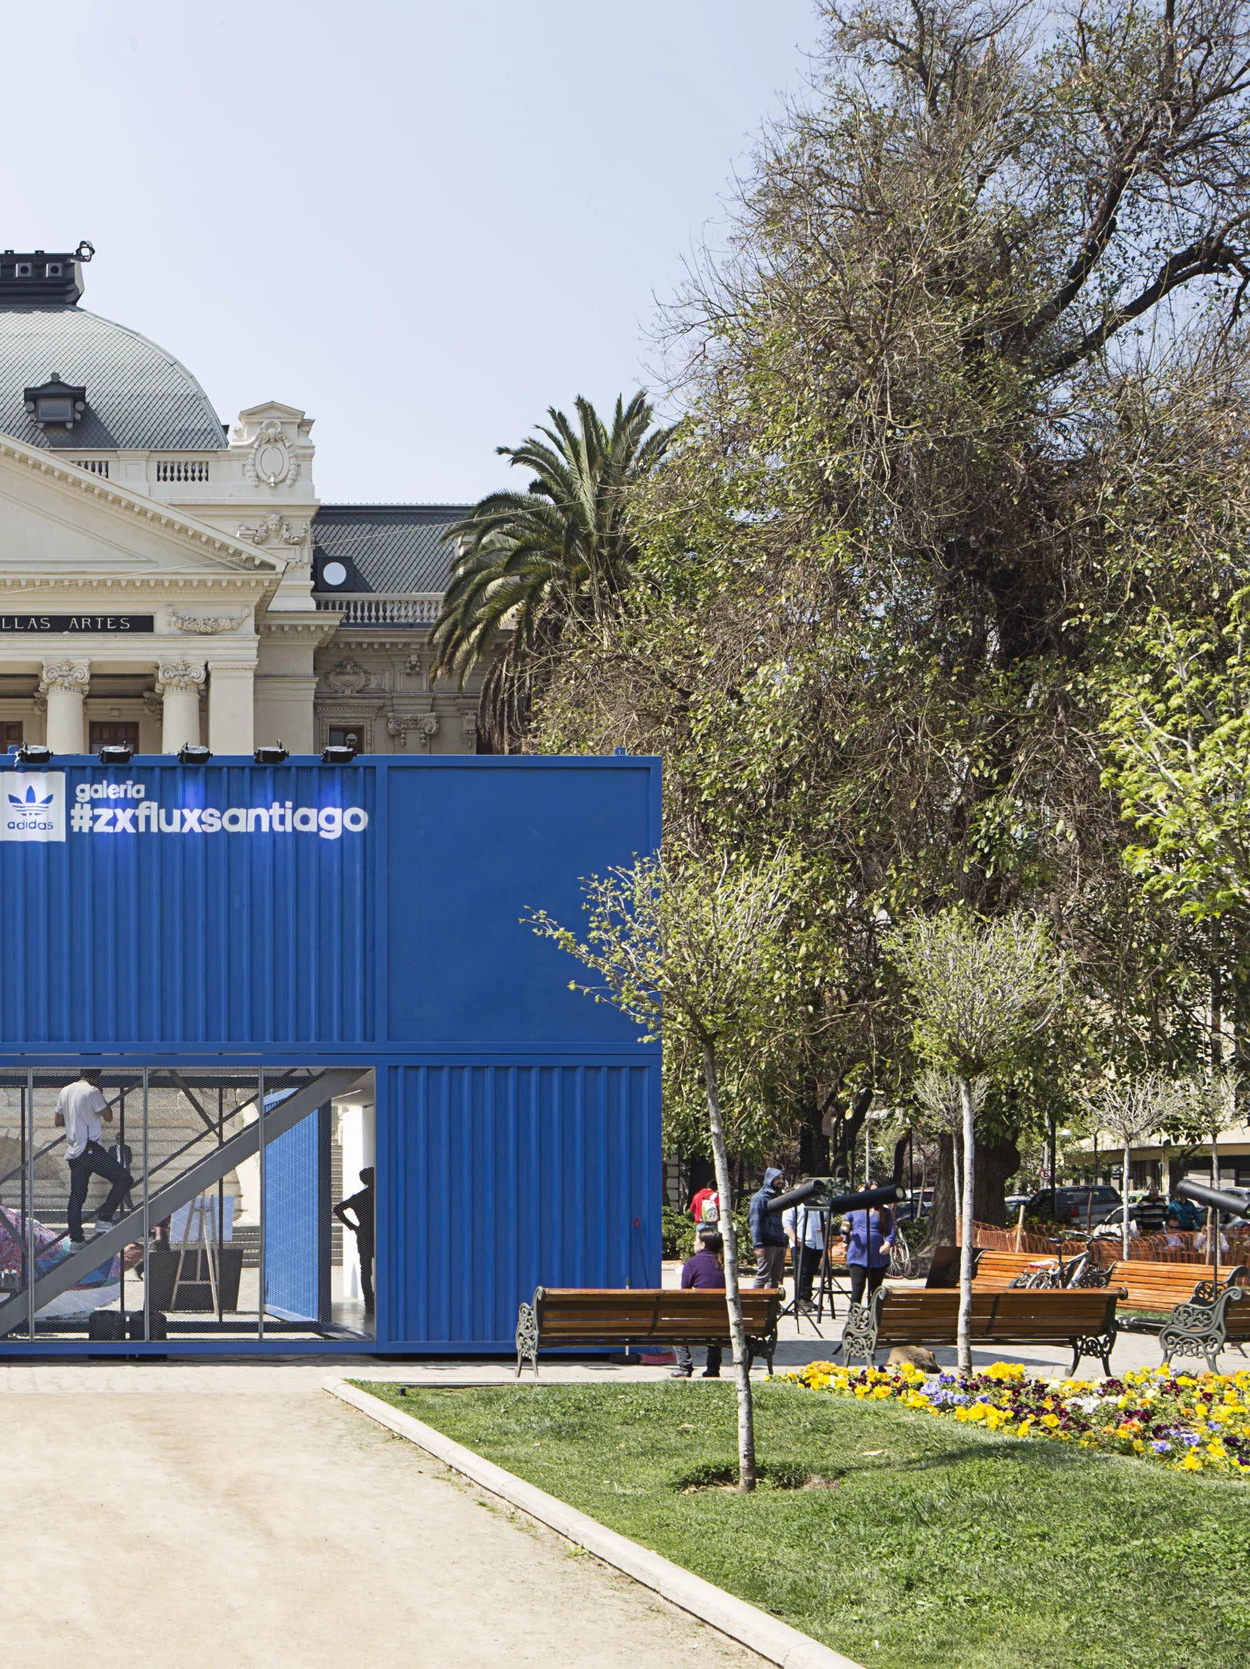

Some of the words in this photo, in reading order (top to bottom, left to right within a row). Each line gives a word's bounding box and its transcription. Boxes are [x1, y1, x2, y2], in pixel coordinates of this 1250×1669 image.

[68, 617, 131, 630] ARTES
[7, 819, 54, 831] adidas
[70, 800, 369, 840] #zxfluxsantiago
